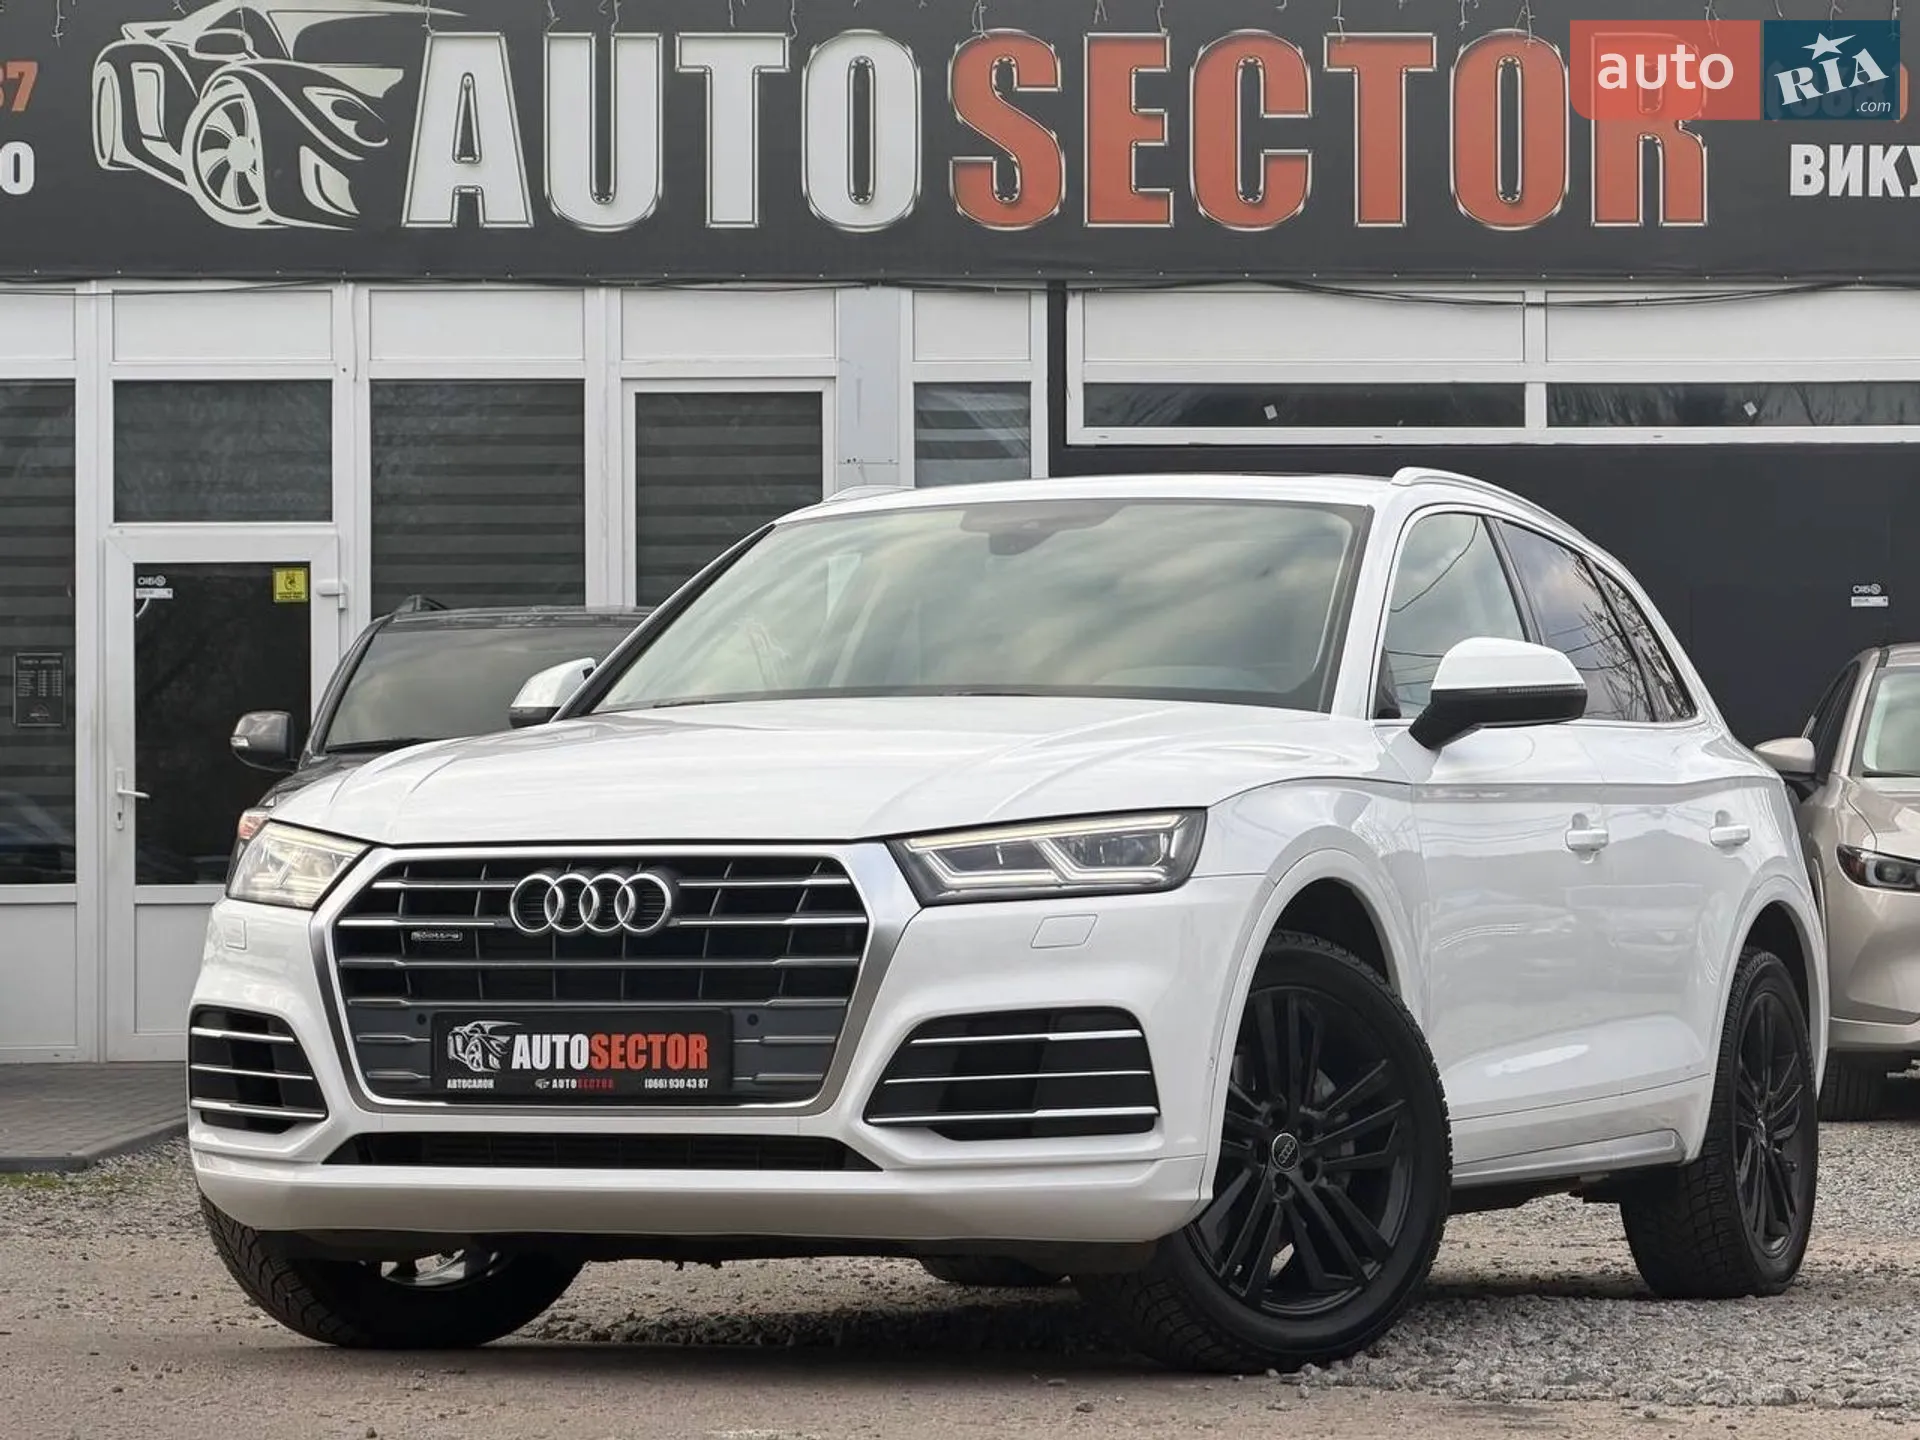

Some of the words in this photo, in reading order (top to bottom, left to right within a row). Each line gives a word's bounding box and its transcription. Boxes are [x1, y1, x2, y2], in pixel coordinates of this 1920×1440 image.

[0, 61, 38, 111] 7
[511, 1032, 708, 1070] AUTOSECTOR
[669, 1078, 685, 1089] 930
[686, 1078, 697, 1089] 43
[697, 1078, 709, 1089] 87
